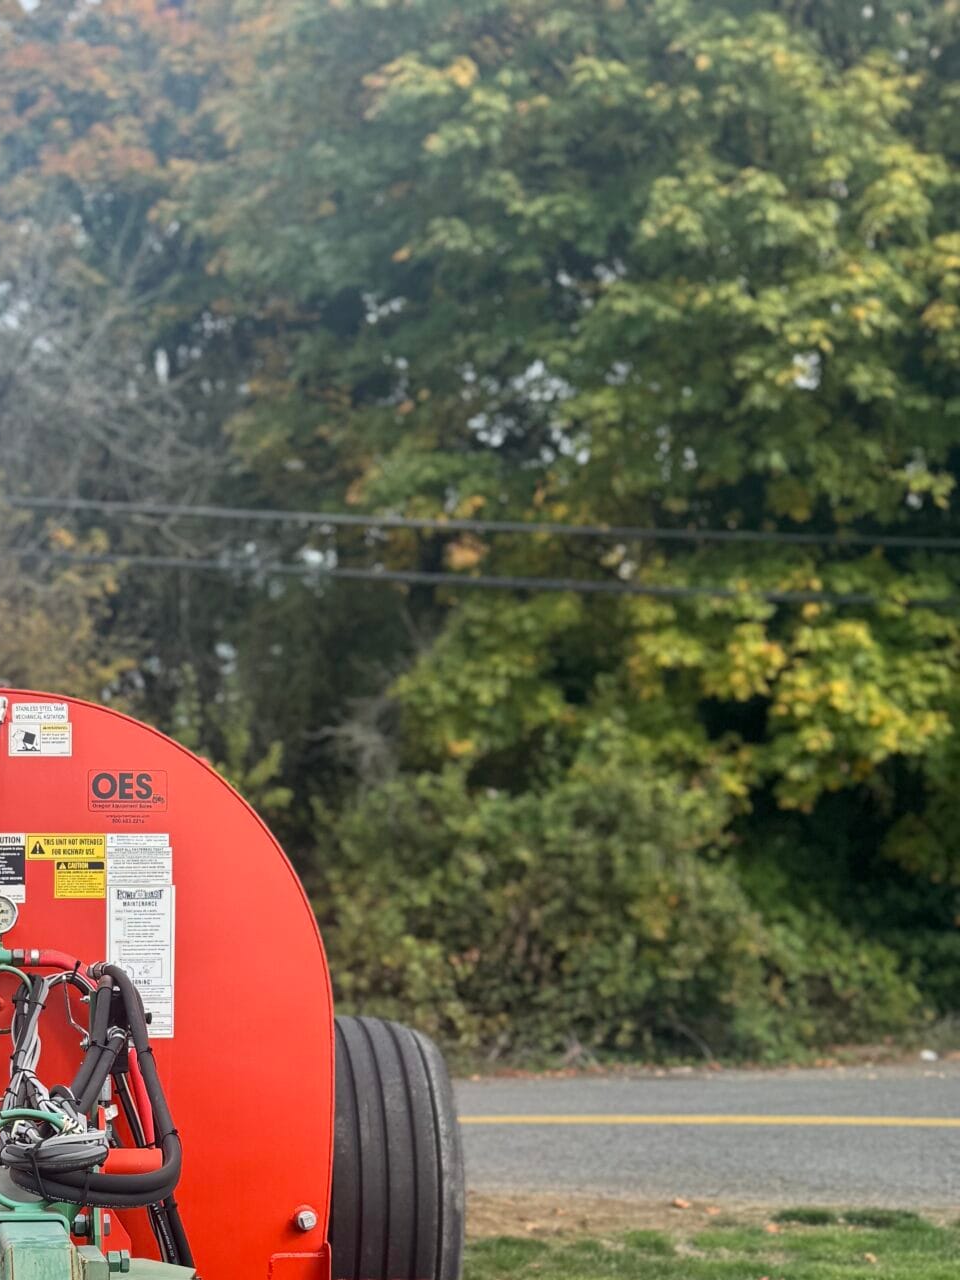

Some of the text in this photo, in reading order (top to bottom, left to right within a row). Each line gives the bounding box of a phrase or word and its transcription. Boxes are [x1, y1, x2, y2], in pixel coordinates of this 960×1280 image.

[92, 772, 153, 800] OES
[43, 838, 103, 846] THIS UNIT NOT INTENDED
[52, 848, 95, 856] FOR HIGHWAY USE
